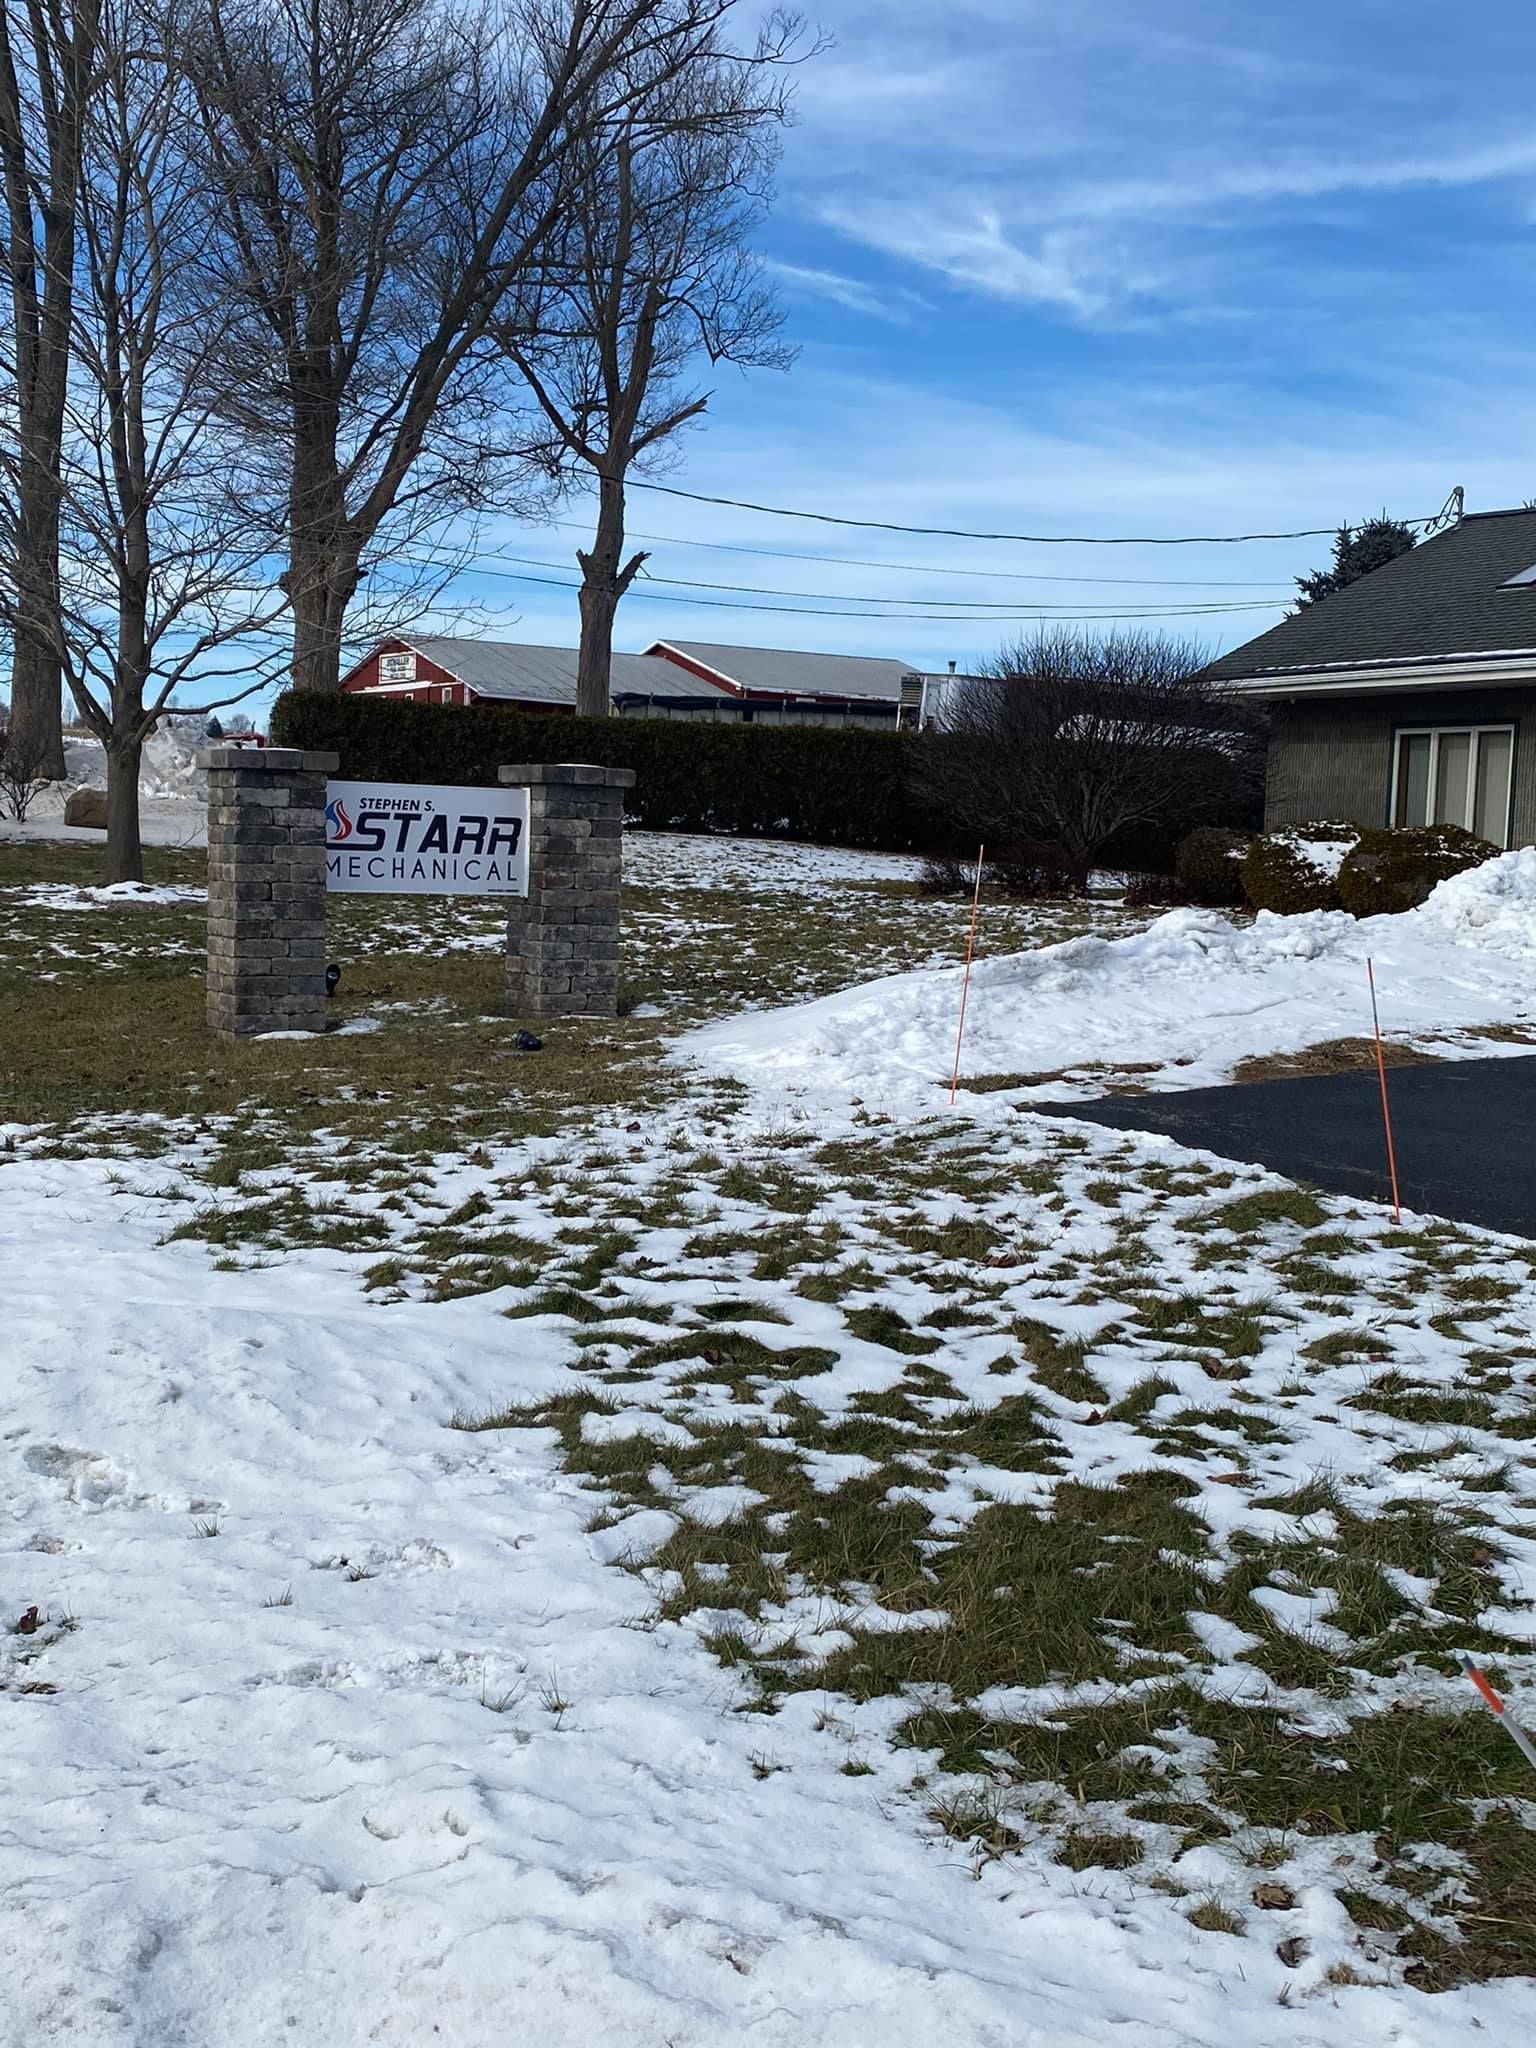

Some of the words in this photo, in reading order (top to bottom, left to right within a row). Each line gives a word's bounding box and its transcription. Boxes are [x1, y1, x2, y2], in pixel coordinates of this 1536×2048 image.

[359, 797, 420, 812] STEPHEN
[424, 801, 435, 812] S.
[326, 812, 522, 856] STARR
[326, 856, 518, 881] MECHANICAL
